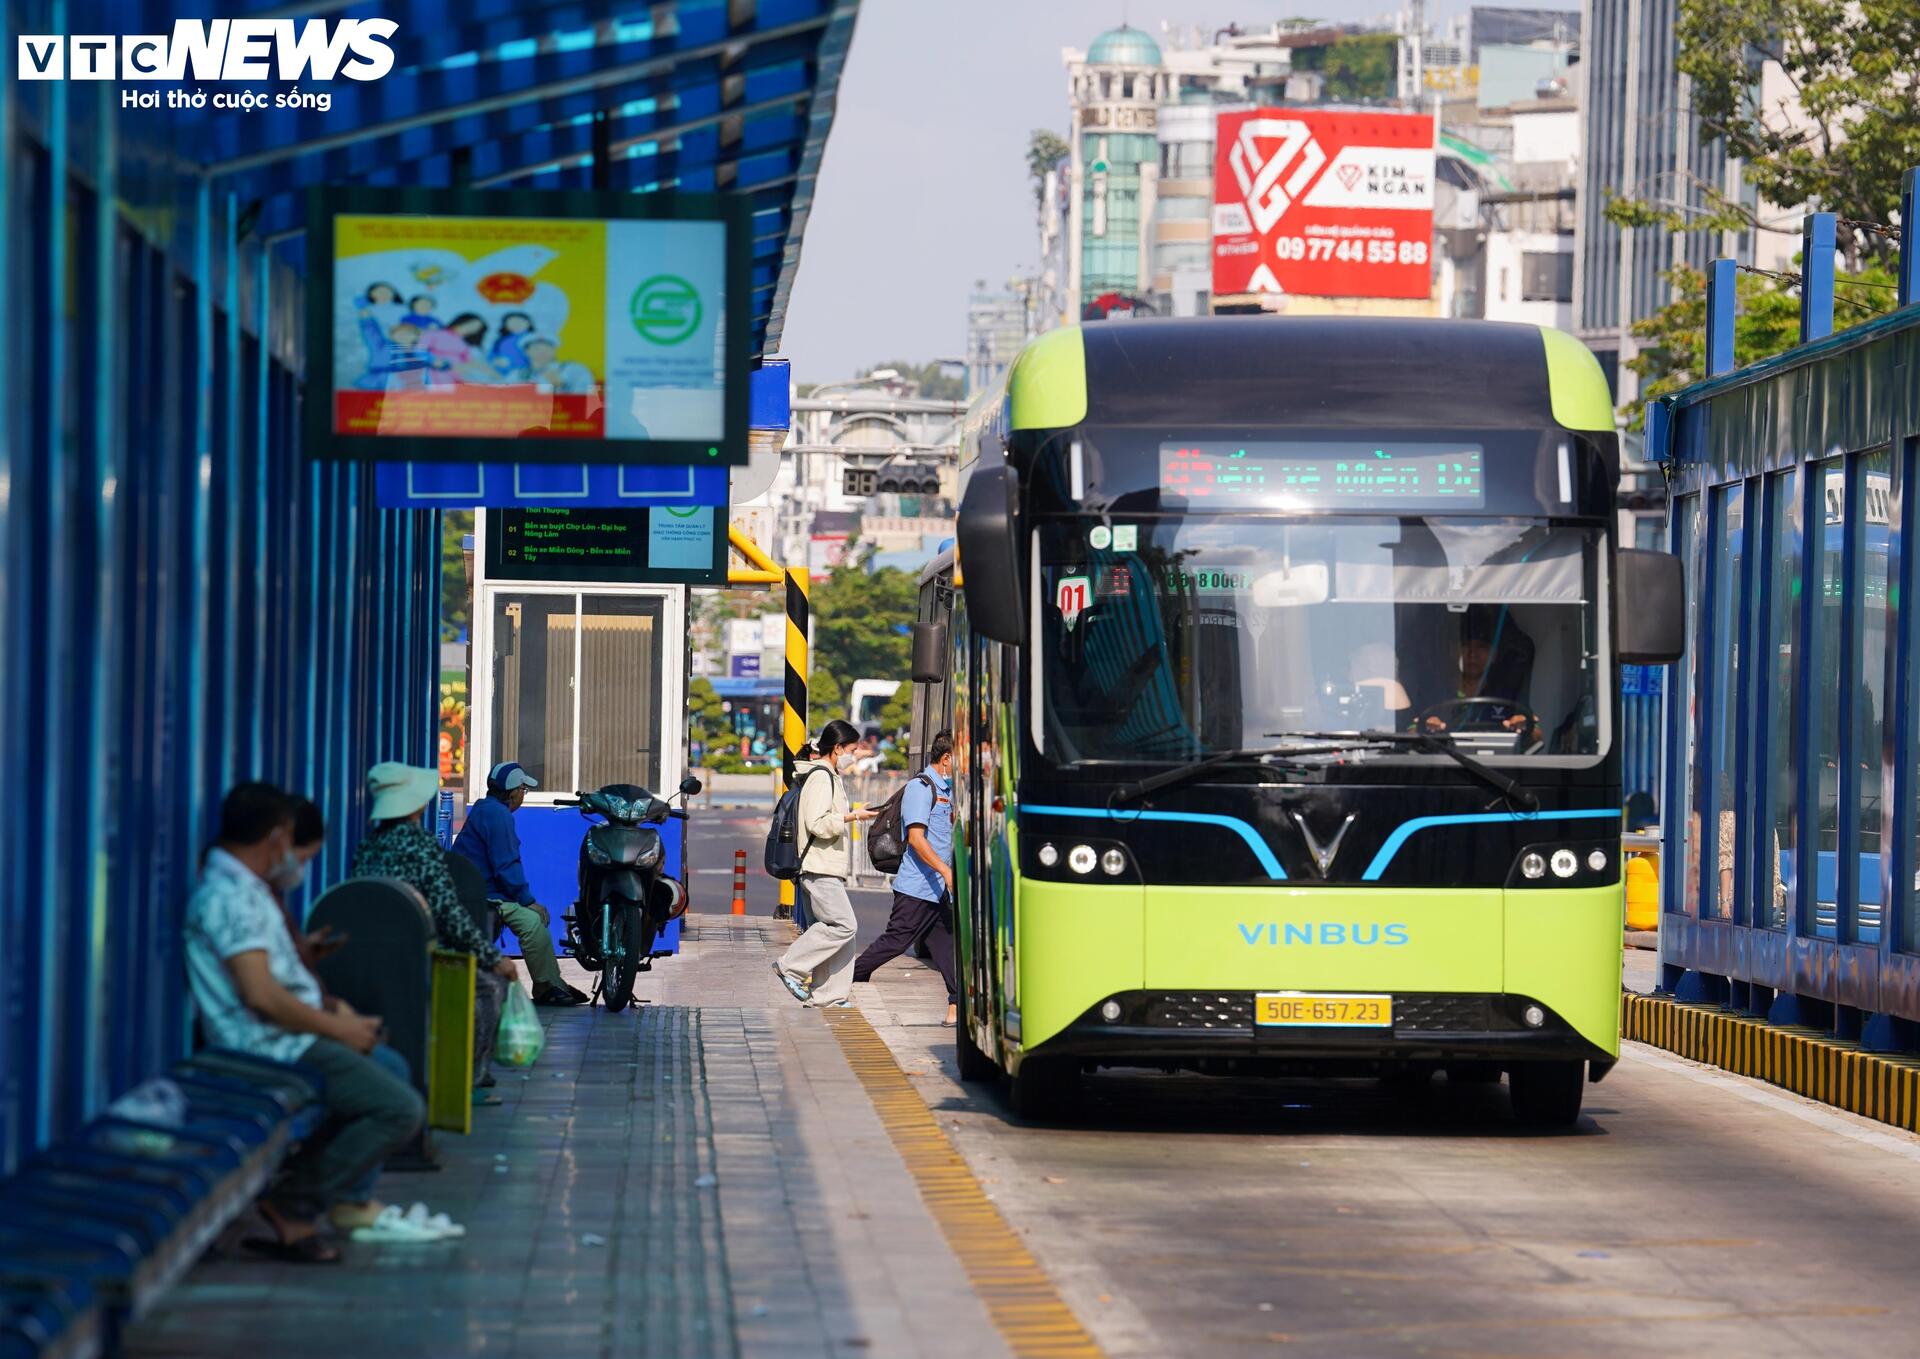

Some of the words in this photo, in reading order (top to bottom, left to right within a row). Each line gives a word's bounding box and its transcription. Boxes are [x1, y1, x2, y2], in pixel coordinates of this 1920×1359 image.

[1368, 166, 1406, 177] KIM
[1060, 584, 1086, 612] 01
[1237, 922, 1409, 945] VINBUS
[1267, 1002, 1380, 1020] 50E-657.23
